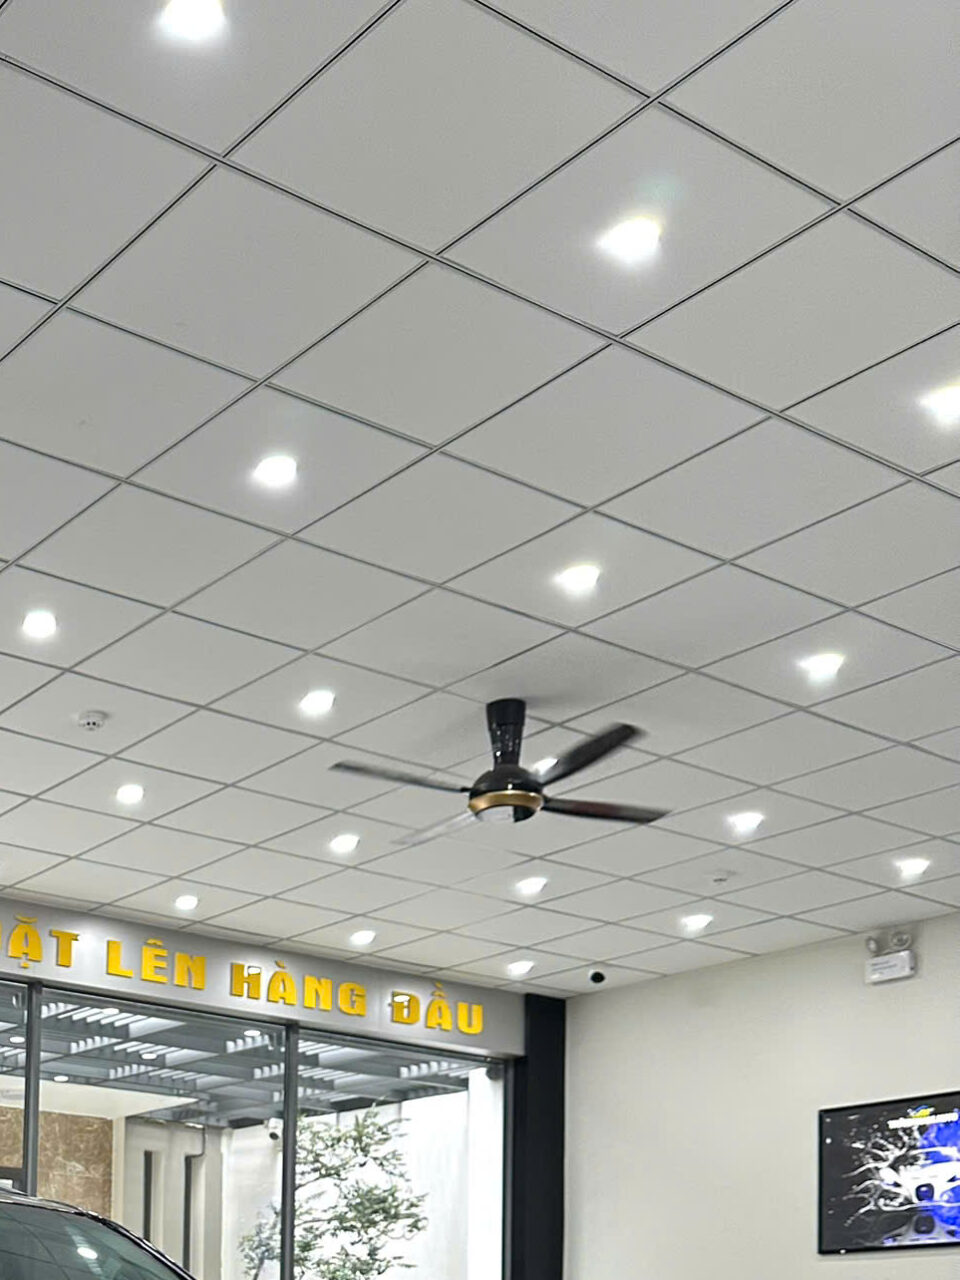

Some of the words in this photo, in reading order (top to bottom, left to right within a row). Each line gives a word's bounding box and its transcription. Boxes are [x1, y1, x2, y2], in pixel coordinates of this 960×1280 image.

[106, 937, 208, 991] LÊN
[231, 960, 368, 1018] HÀNG
[391, 979, 486, 1037] ĐẦU
